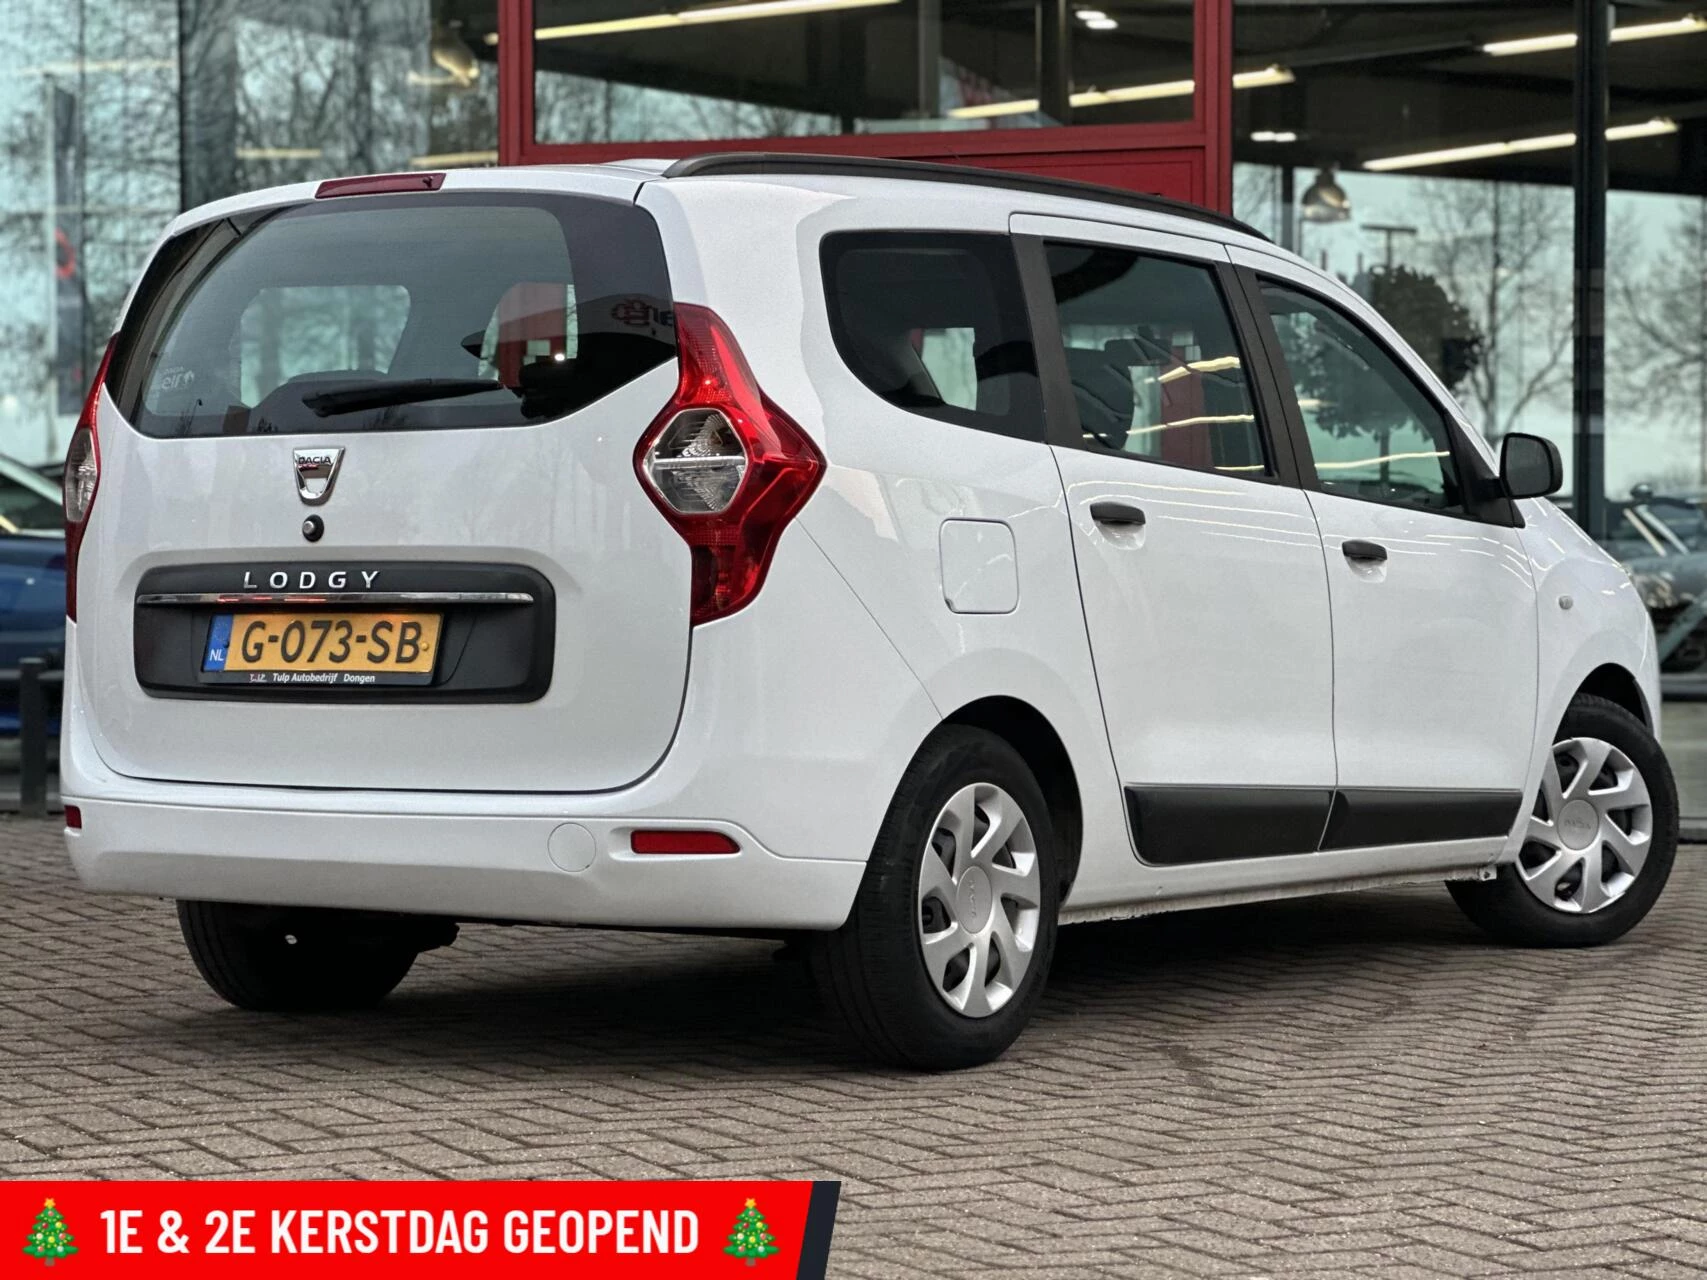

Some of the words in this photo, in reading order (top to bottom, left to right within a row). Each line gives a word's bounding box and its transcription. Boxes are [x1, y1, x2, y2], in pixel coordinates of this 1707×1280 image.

[298, 456, 332, 465] DACIA
[243, 571, 379, 589] LODGY
[241, 620, 422, 664] G-073-SB
[209, 648, 225, 662] NL
[272, 672, 290, 684] Tulp
[291, 672, 338, 685] Autobedrijf
[343, 673, 376, 685] Dongen
